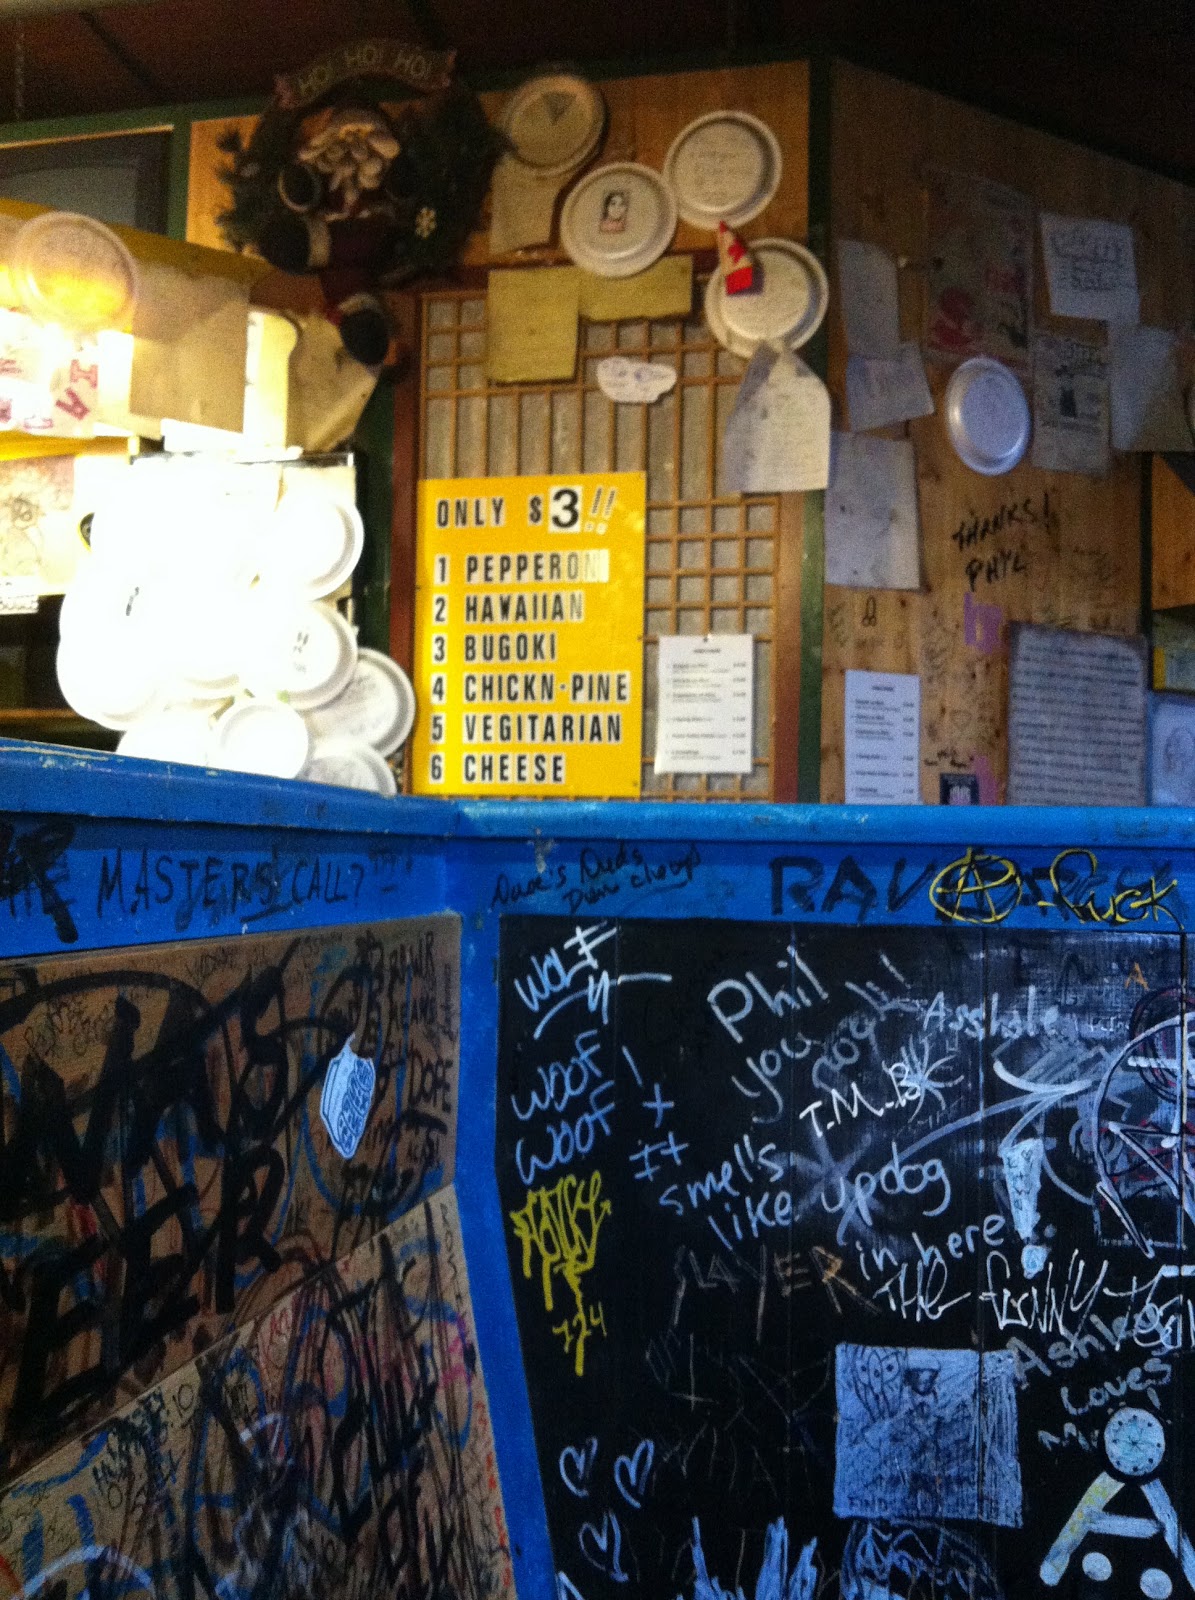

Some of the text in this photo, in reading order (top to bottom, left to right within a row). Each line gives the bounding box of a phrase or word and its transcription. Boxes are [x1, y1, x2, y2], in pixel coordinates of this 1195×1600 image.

[437, 498, 504, 528] ONLY
[437, 556, 447, 583] 1
[434, 592, 583, 623] 2 HAWAIIAN
[434, 634, 556, 662] 3 BUGOKI
[432, 676, 444, 701] 4
[431, 714, 622, 742] 5 VEGITARIAN
[430, 755, 563, 782] 6 CHEESE
[707, 945, 829, 1044] Phil
